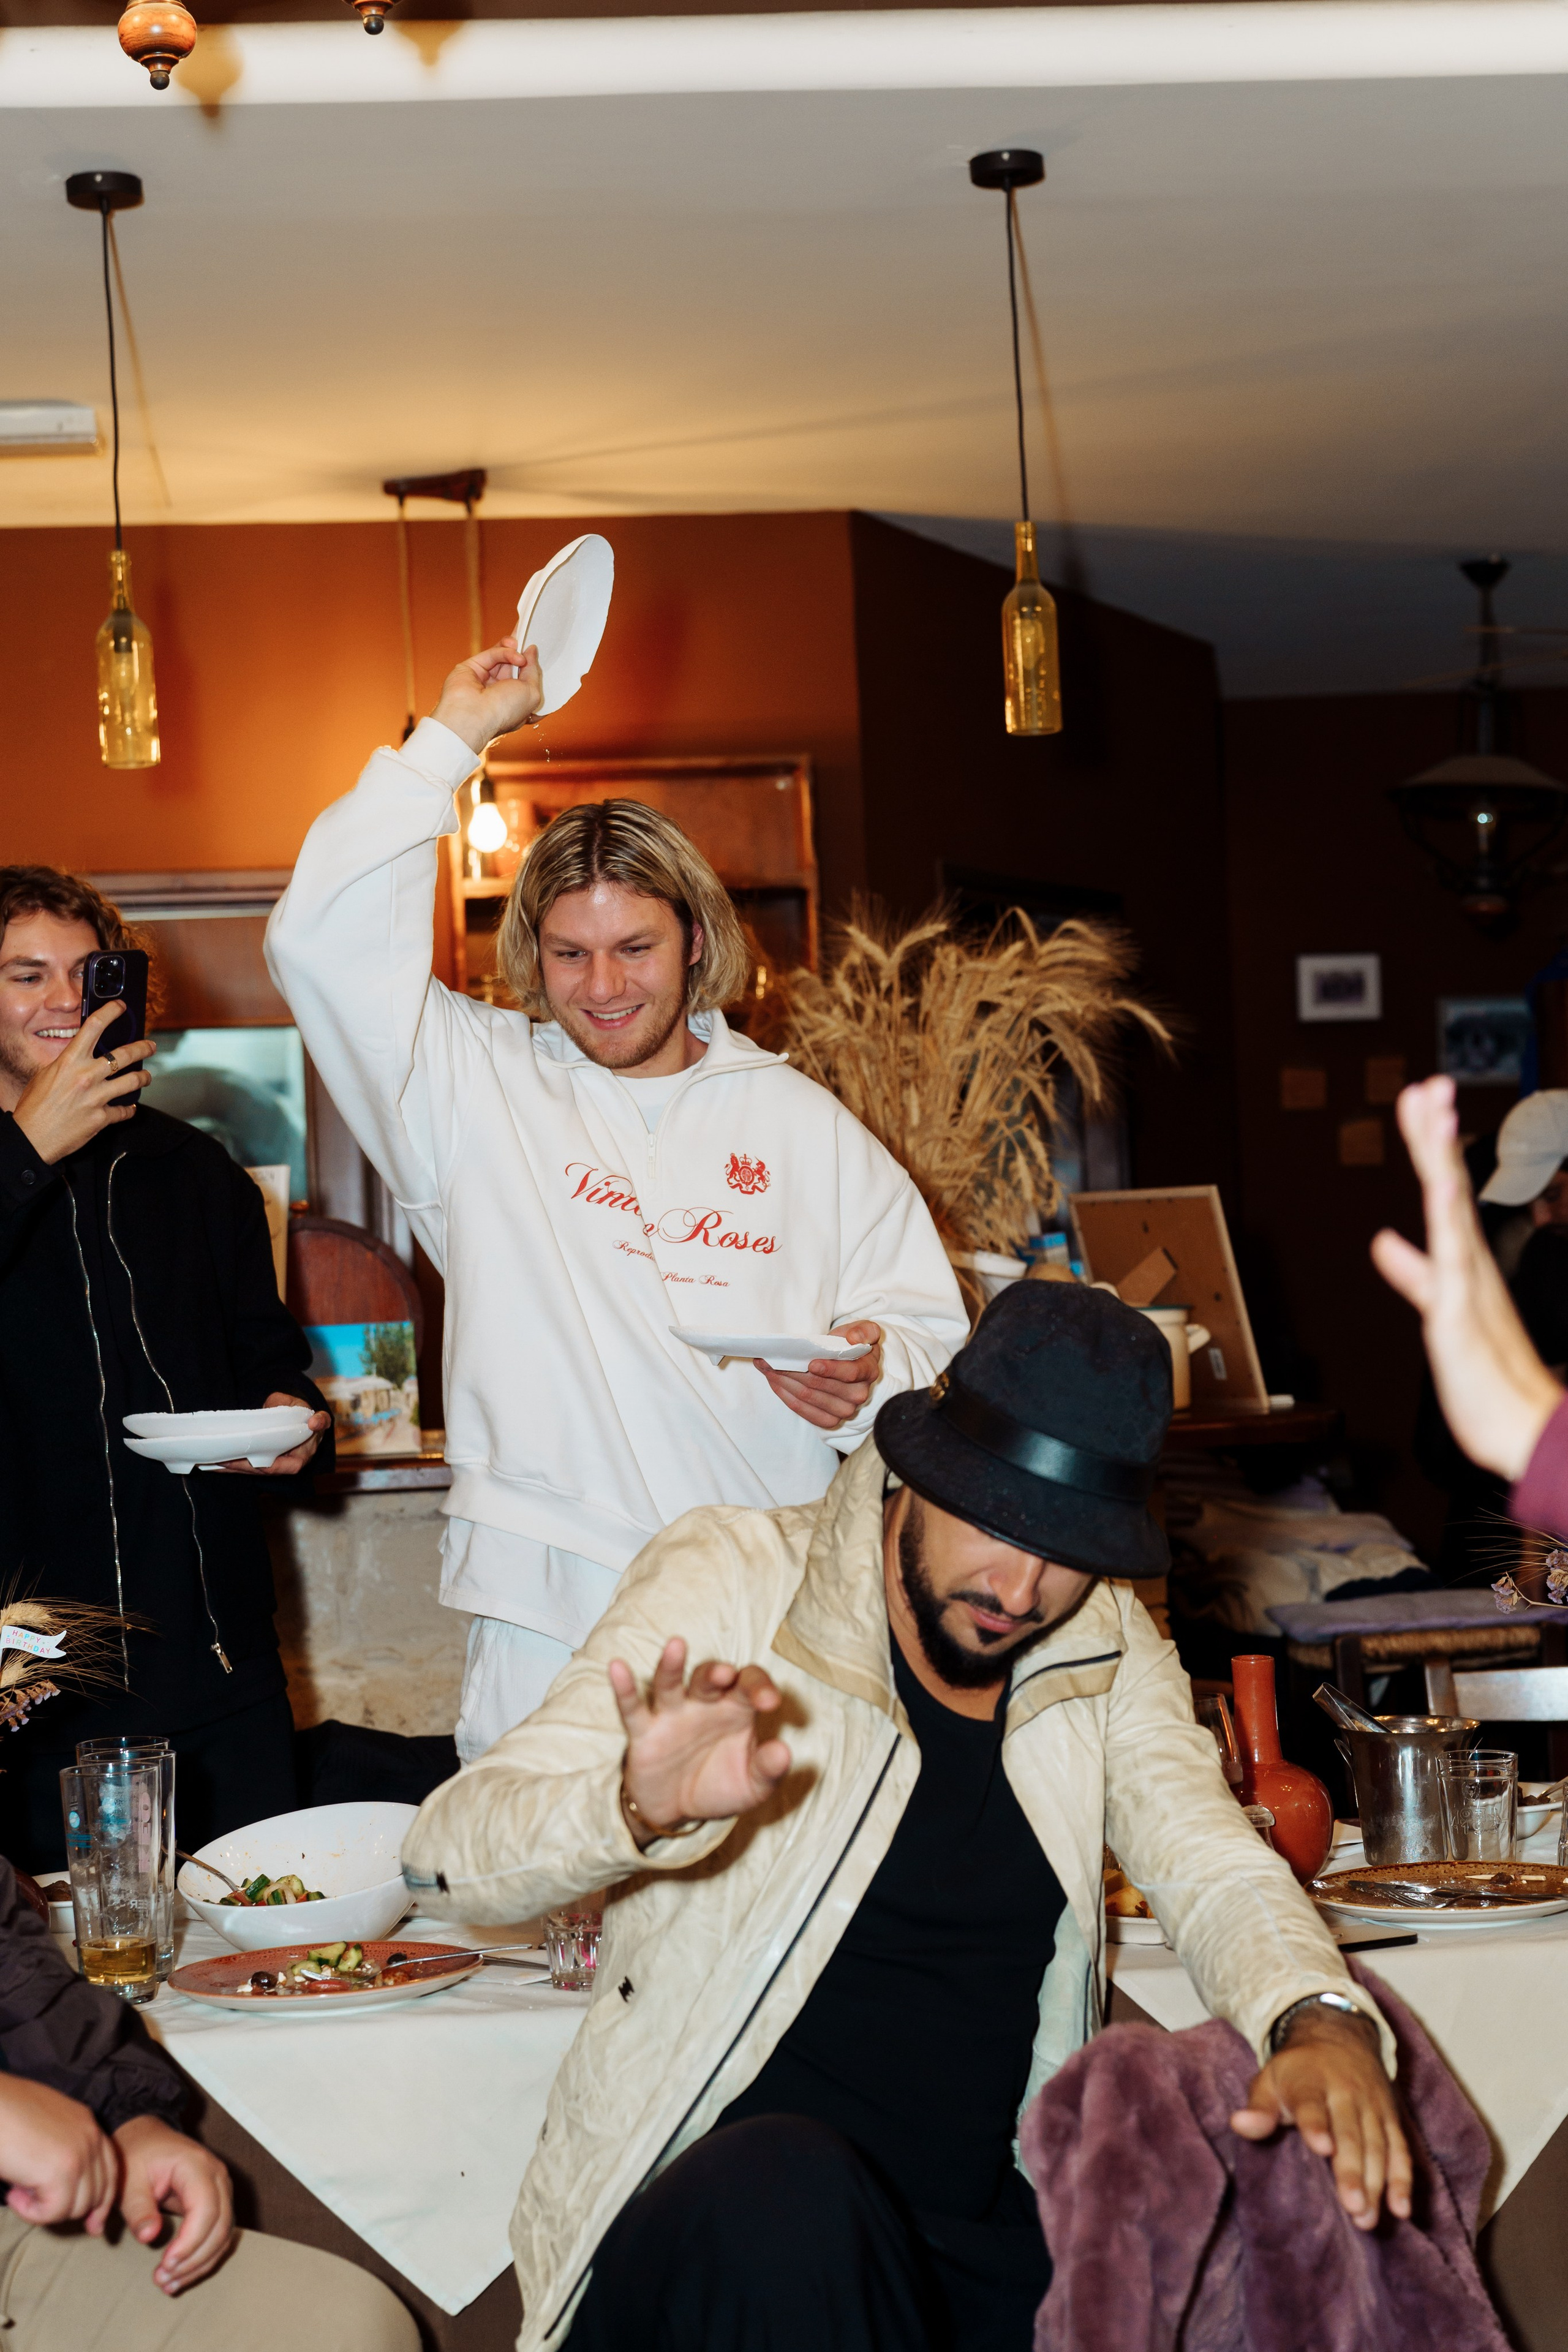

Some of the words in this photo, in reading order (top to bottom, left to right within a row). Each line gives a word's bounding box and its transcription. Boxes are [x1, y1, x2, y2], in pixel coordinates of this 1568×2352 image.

[657, 1207, 783, 1254] Roses
[661, 1271, 695, 1283] Planta
[699, 1274, 730, 1287] Rosa
[12, 1629, 41, 1643] HAPPY
[6, 1637, 50, 1654] BIRTHDAY
